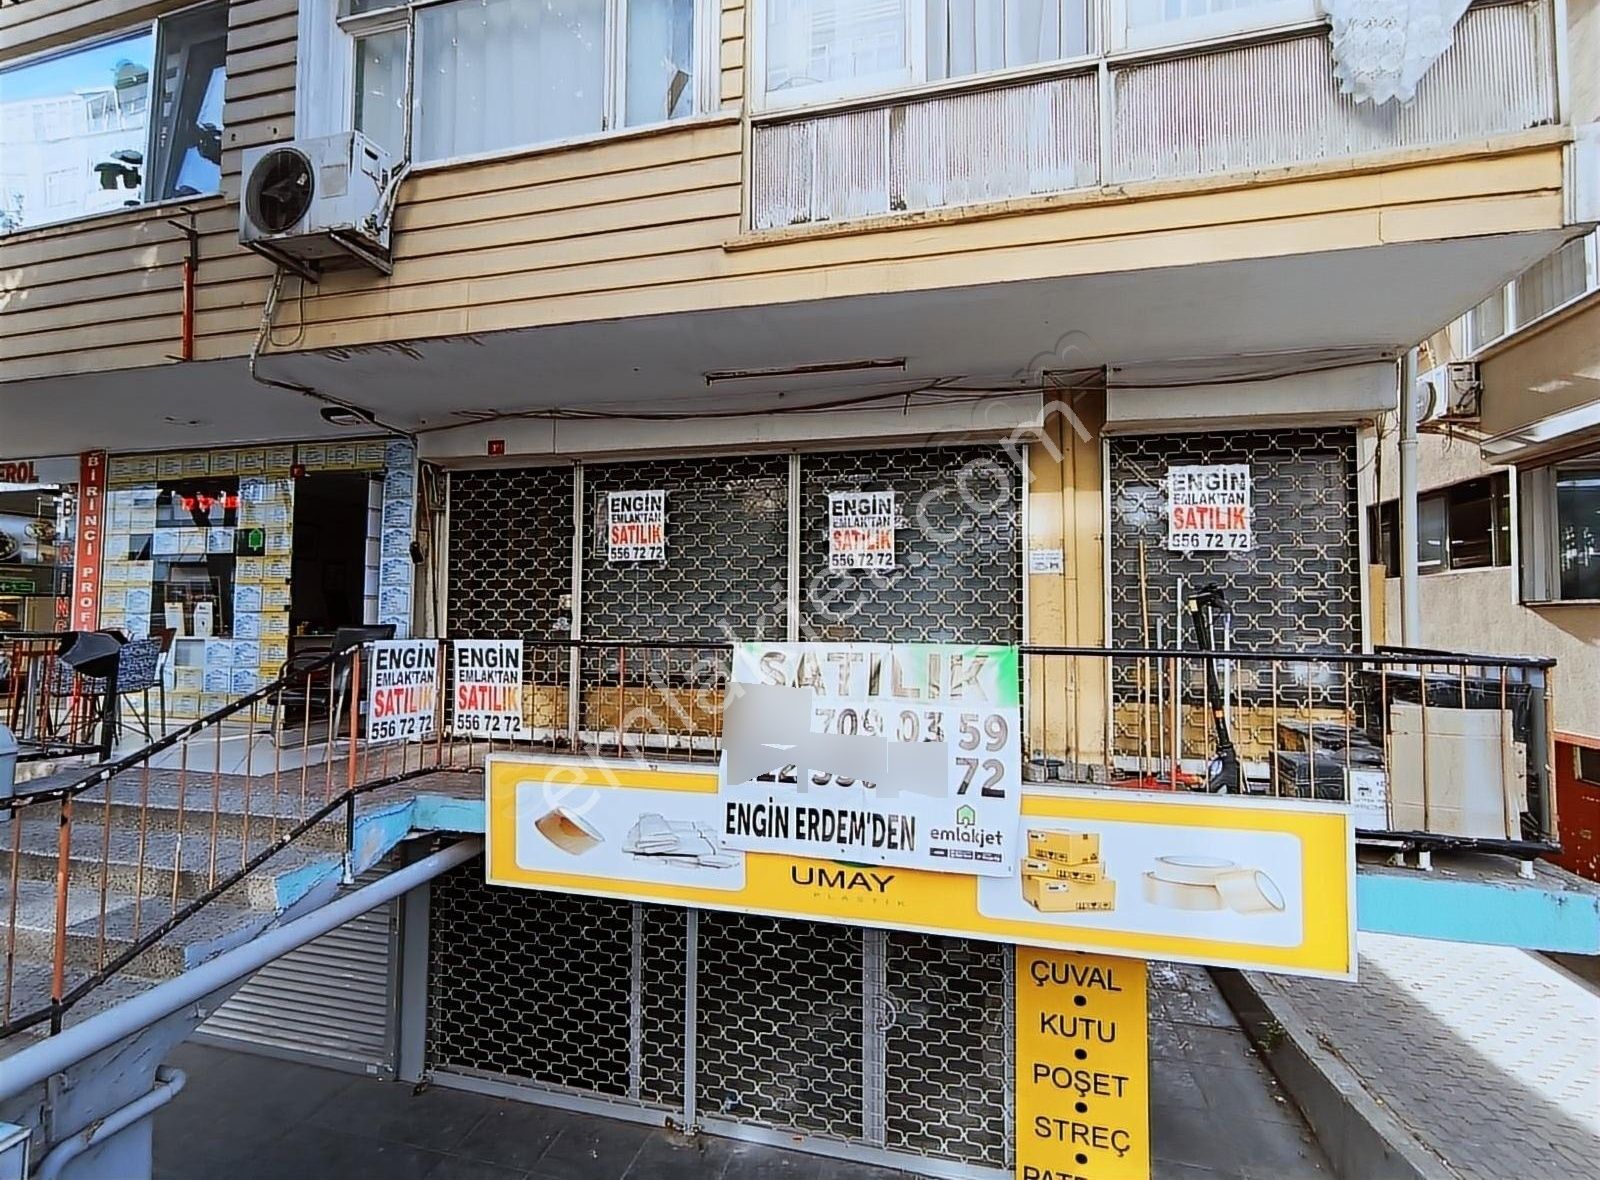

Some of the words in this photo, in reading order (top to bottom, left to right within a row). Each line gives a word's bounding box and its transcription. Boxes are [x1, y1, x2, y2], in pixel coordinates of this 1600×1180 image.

[1172, 468, 1246, 491] ENGİN
[611, 493, 662, 512] ENGİN
[832, 494, 891, 516] ENGİN
[1173, 506, 1246, 530] SATILIK
[612, 524, 661, 545] SATILIK
[833, 529, 891, 551] SATILIK
[1172, 533, 1200, 548] 556
[1205, 533, 1224, 548] 72
[1229, 533, 1248, 548] 72
[610, 547, 630, 559] 556
[632, 547, 646, 559] 72
[649, 546, 663, 559] 72
[831, 553, 854, 567] 556
[858, 553, 874, 566] 72
[877, 552, 893, 566] 72
[376, 643, 435, 670] ENGİN
[458, 643, 519, 668] ENGİN
[375, 670, 434, 687] EMLAK'TAN
[458, 669, 518, 684] EMLAK'TAN
[760, 650, 989, 701] SATILIK
[374, 686, 433, 719] SATILIK
[458, 684, 518, 711] SATILIK
[371, 720, 396, 740] 556
[399, 718, 415, 736] 72
[419, 715, 432, 732] 72
[457, 713, 480, 731] 556
[484, 715, 500, 731] 72
[504, 716, 521, 732] 72
[959, 713, 1008, 752] 59
[955, 757, 1006, 798] 72
[726, 796, 789, 839] ENGİN
[795, 807, 916, 851] ERDEM'DEN
[930, 826, 1003, 848] emlakjet
[791, 865, 895, 893] UMAY
[1030, 959, 1122, 992] ÇUVAL
[1040, 1011, 1116, 1043] KUTU
[1033, 1063, 1129, 1098] POŞET
[1034, 1115, 1131, 1158] STREÇ
